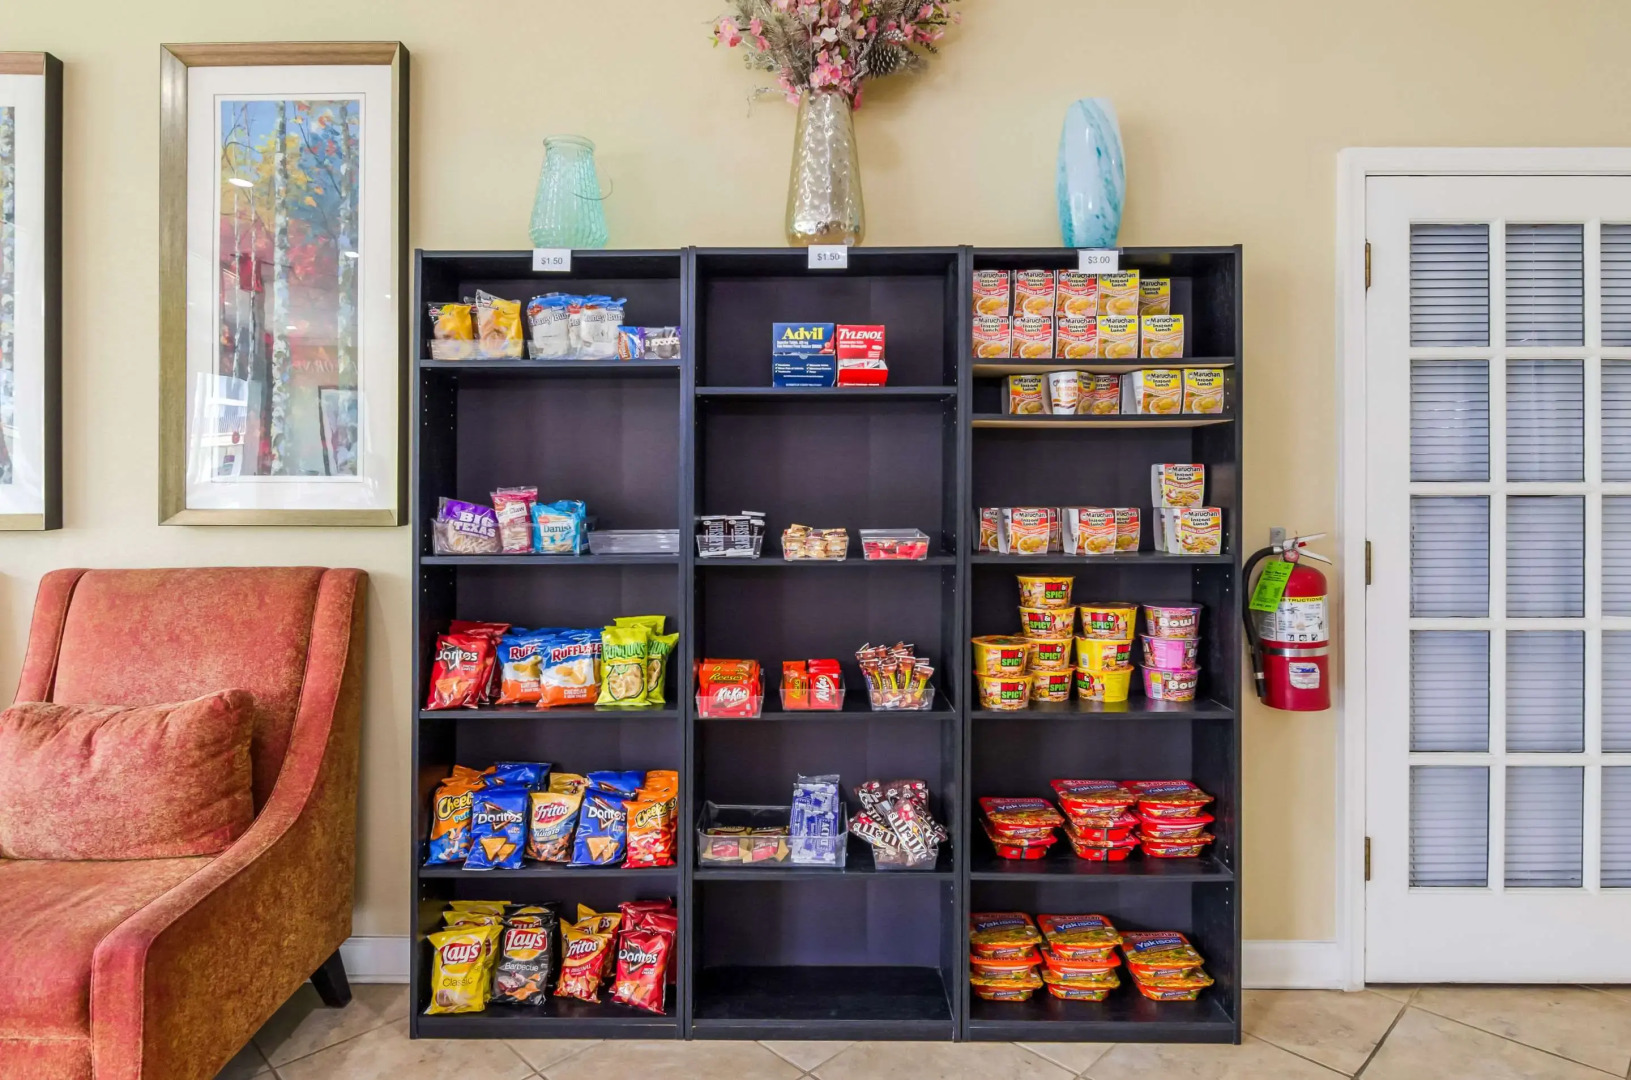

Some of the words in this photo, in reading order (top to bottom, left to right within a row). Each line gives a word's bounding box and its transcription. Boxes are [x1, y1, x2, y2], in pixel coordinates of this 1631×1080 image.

[540, 257, 563, 265] $1.50
[817, 252, 840, 261] $1.50
[1087, 256, 1110, 264] $3.00
[782, 327, 824, 340] Advil
[839, 328, 883, 340] TYLENOL
[460, 511, 494, 528] BIG
[453, 521, 496, 538] TEXAS
[1029, 621, 1052, 629] SPICY
[1091, 621, 1114, 629] SPICY
[709, 672, 743, 681] Reese's
[535, 804, 569, 821] Fritos
[567, 939, 599, 957] Fritos
[619, 949, 658, 963] Doritos
[504, 962, 539, 972] Barbecue
